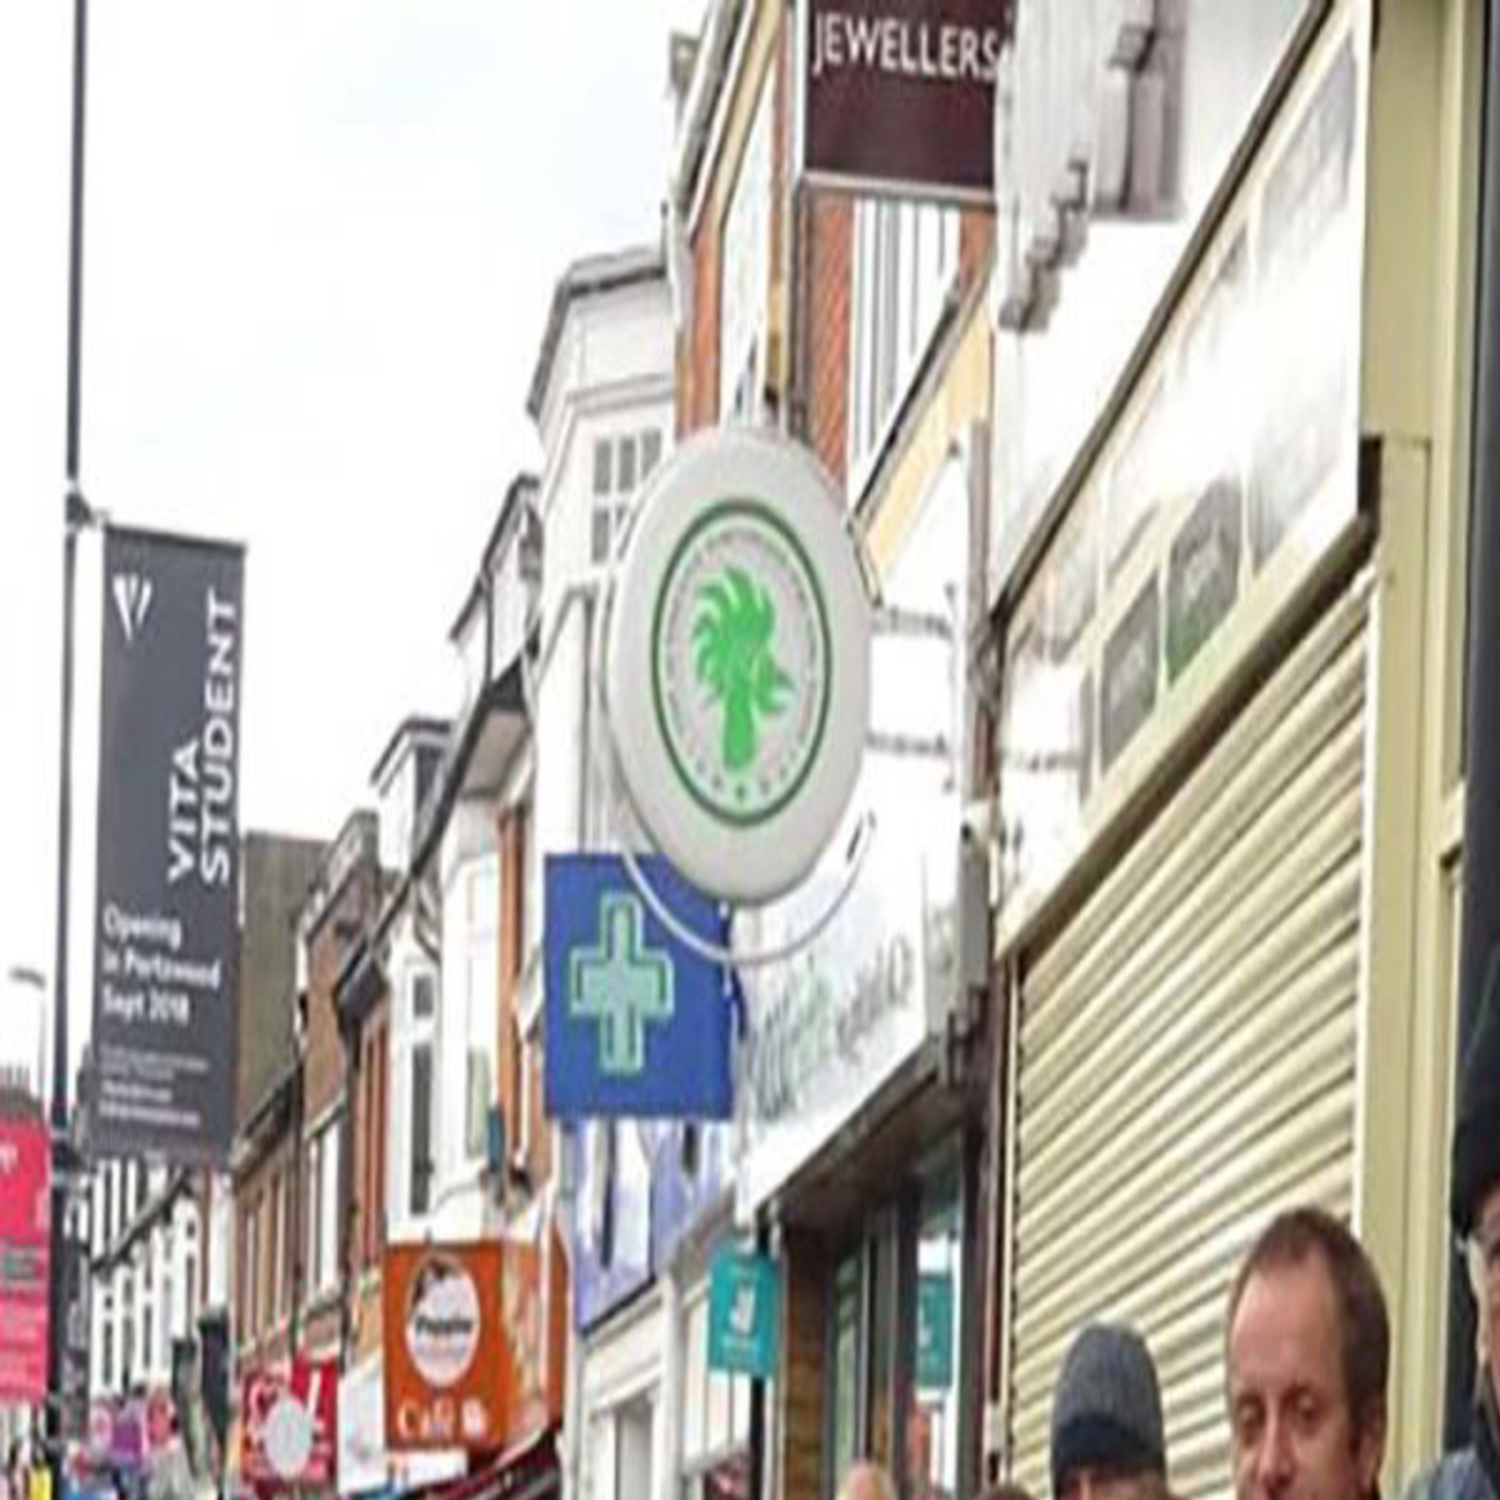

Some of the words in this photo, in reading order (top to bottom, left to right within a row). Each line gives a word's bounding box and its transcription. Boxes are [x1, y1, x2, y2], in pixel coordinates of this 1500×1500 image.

[812, 12, 999, 81] JEWELLERS
[201, 585, 236, 886] STUDENT
[167, 737, 198, 884] VITA
